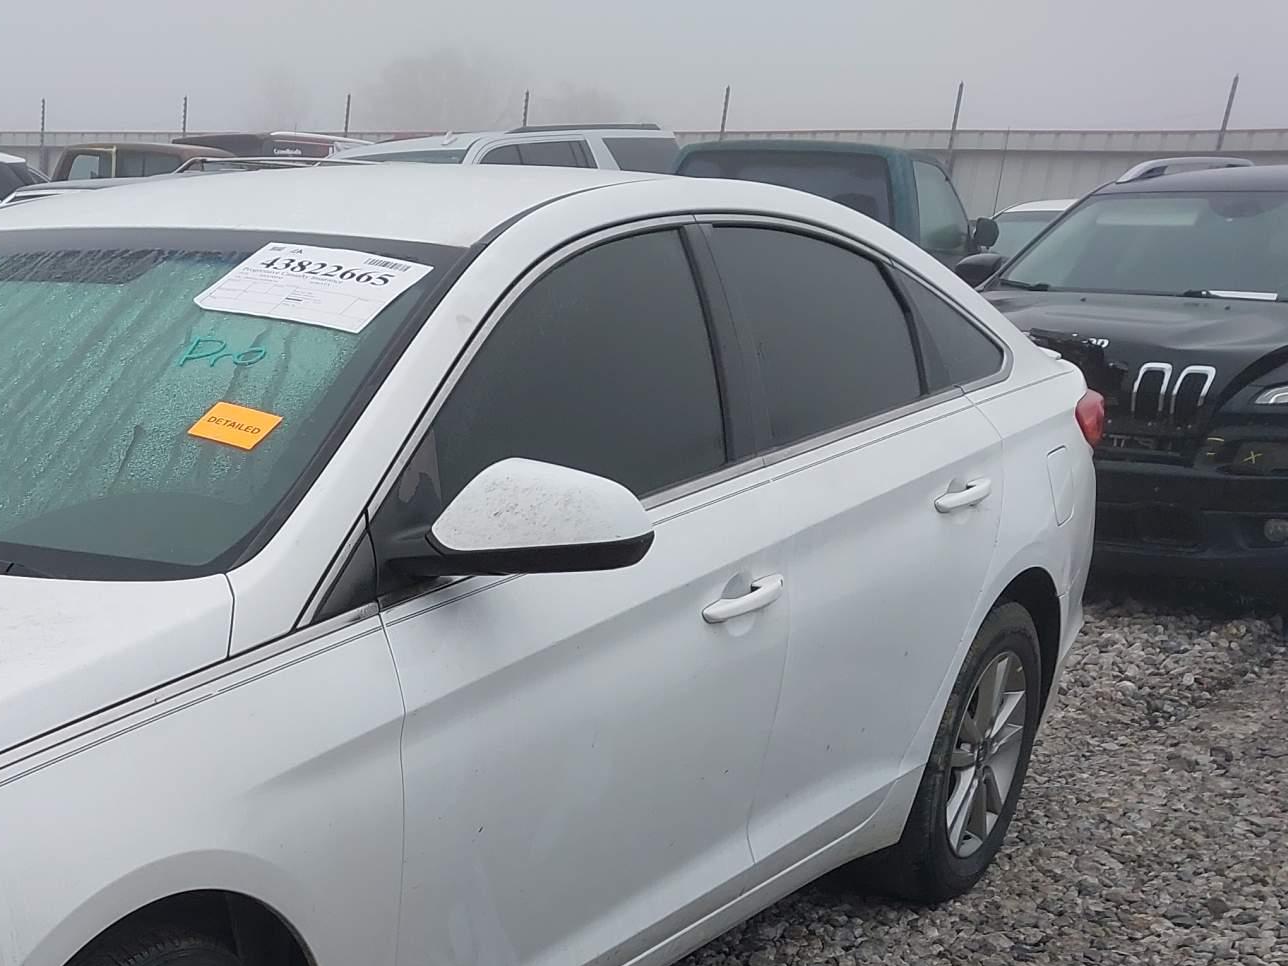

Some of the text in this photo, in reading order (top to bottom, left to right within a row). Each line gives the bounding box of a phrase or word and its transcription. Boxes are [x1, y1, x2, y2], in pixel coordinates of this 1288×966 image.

[260, 257, 395, 286] 43822665
[179, 336, 267, 367] Pro
[207, 416, 261, 435] DETAILED
